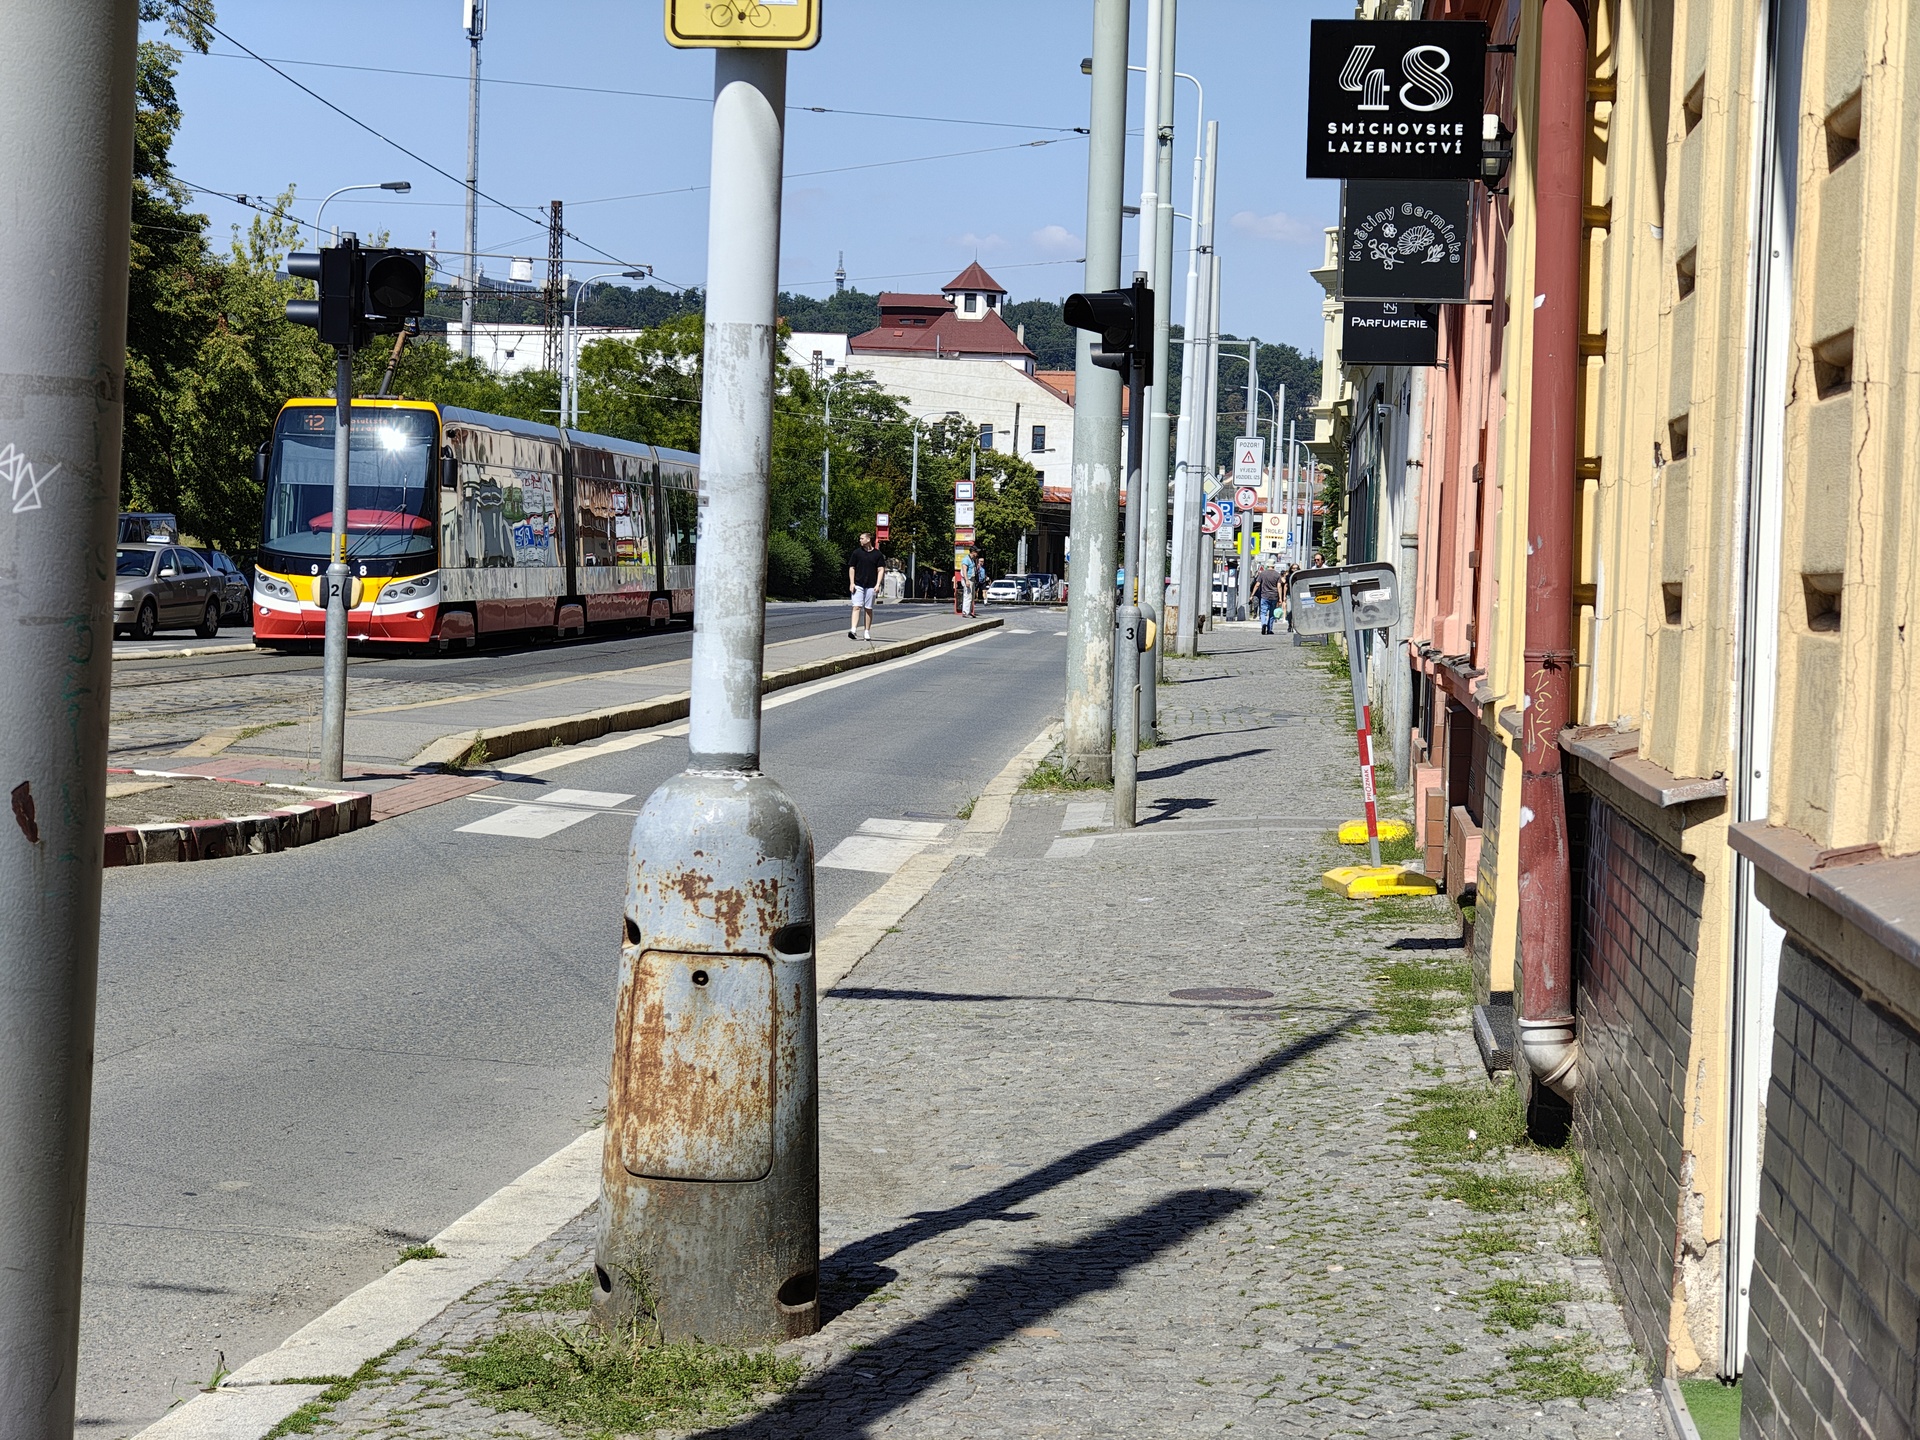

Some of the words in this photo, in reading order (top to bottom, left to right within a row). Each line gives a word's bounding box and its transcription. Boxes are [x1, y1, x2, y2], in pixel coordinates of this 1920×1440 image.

[1338, 44, 1453, 112] 48
[1328, 139, 1462, 154] LAZEBNICTVÍ
[1349, 206, 1395, 262] Květiny
[1401, 202, 1461, 264] Germínka
[304, 414, 325, 431] 12
[1220, 503, 1231, 513] P
[330, 583, 340, 597] 2
[1125, 627, 1135, 641] 3
